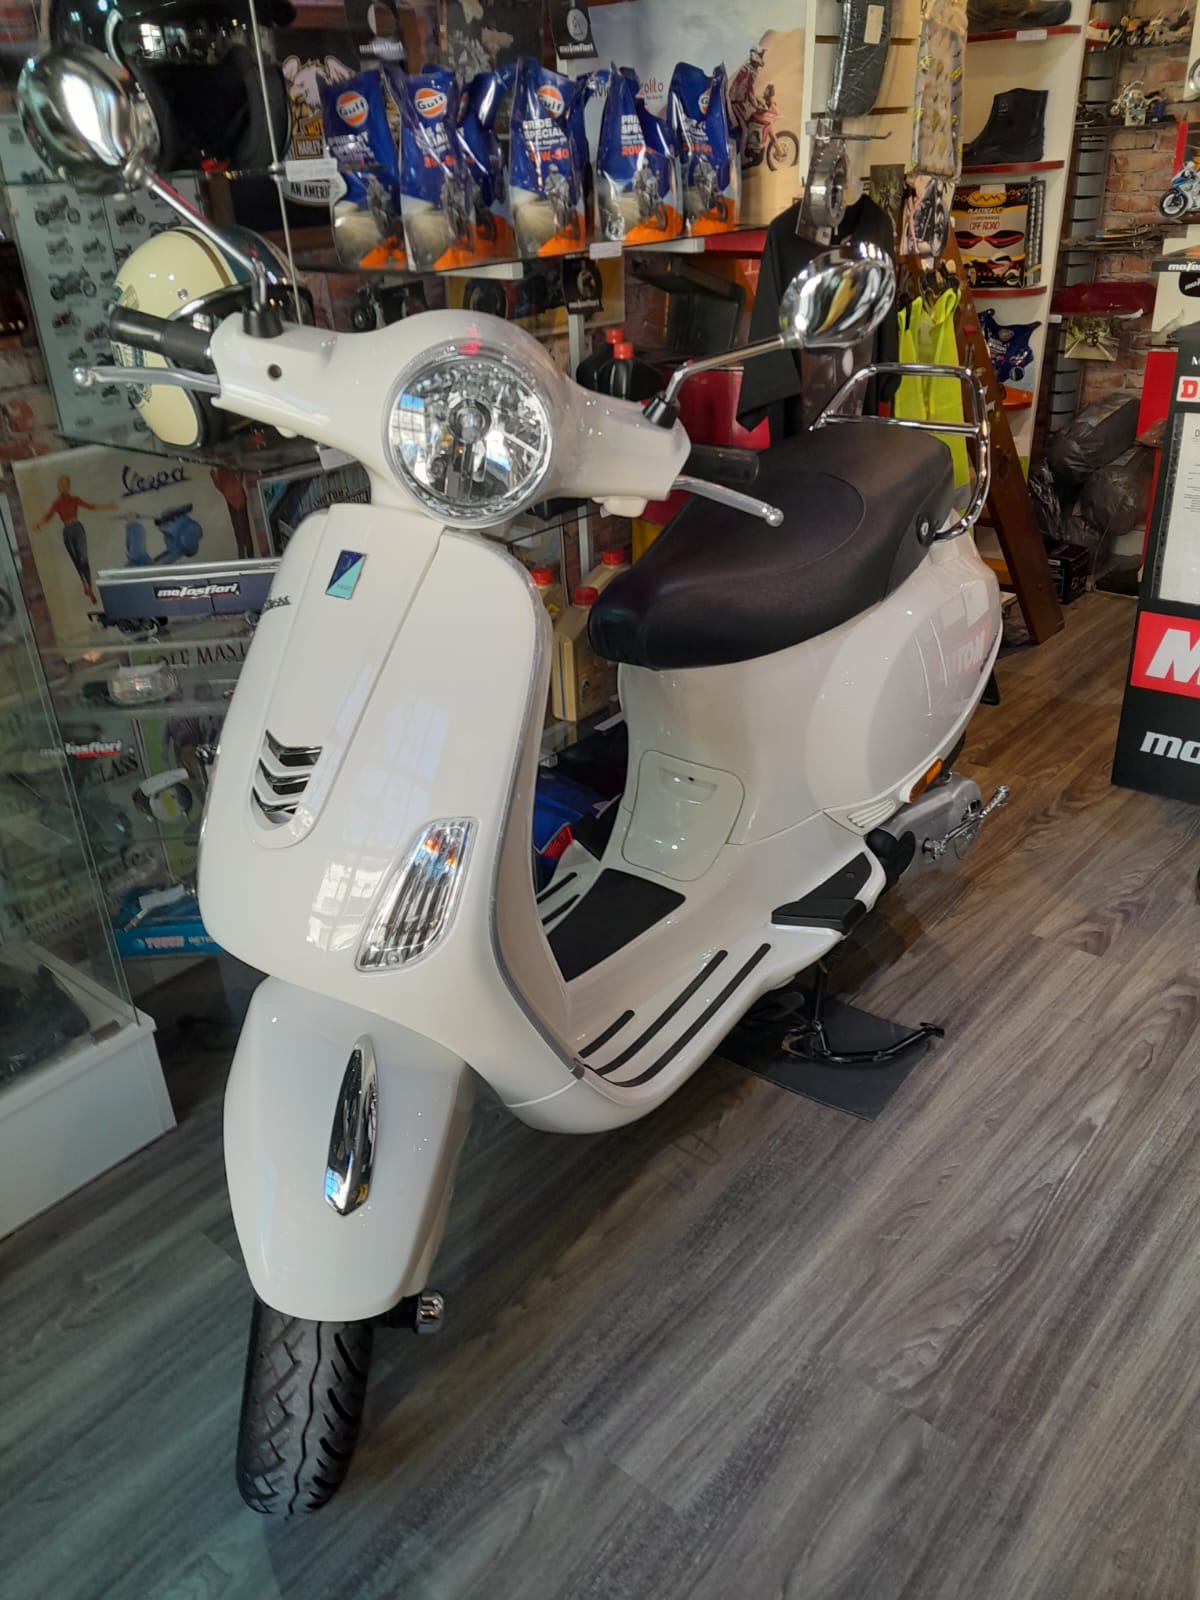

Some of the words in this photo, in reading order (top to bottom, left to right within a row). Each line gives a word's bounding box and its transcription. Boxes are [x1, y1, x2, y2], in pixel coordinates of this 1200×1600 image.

[340, 100, 367, 117] Gulf
[417, 95, 444, 110] Gulf
[522, 118, 552, 130] PRIDE
[291, 181, 302, 196] AN
[969, 221, 981, 231] OFF
[982, 220, 1000, 231] ROAD
[121, 464, 191, 498] Vespa
